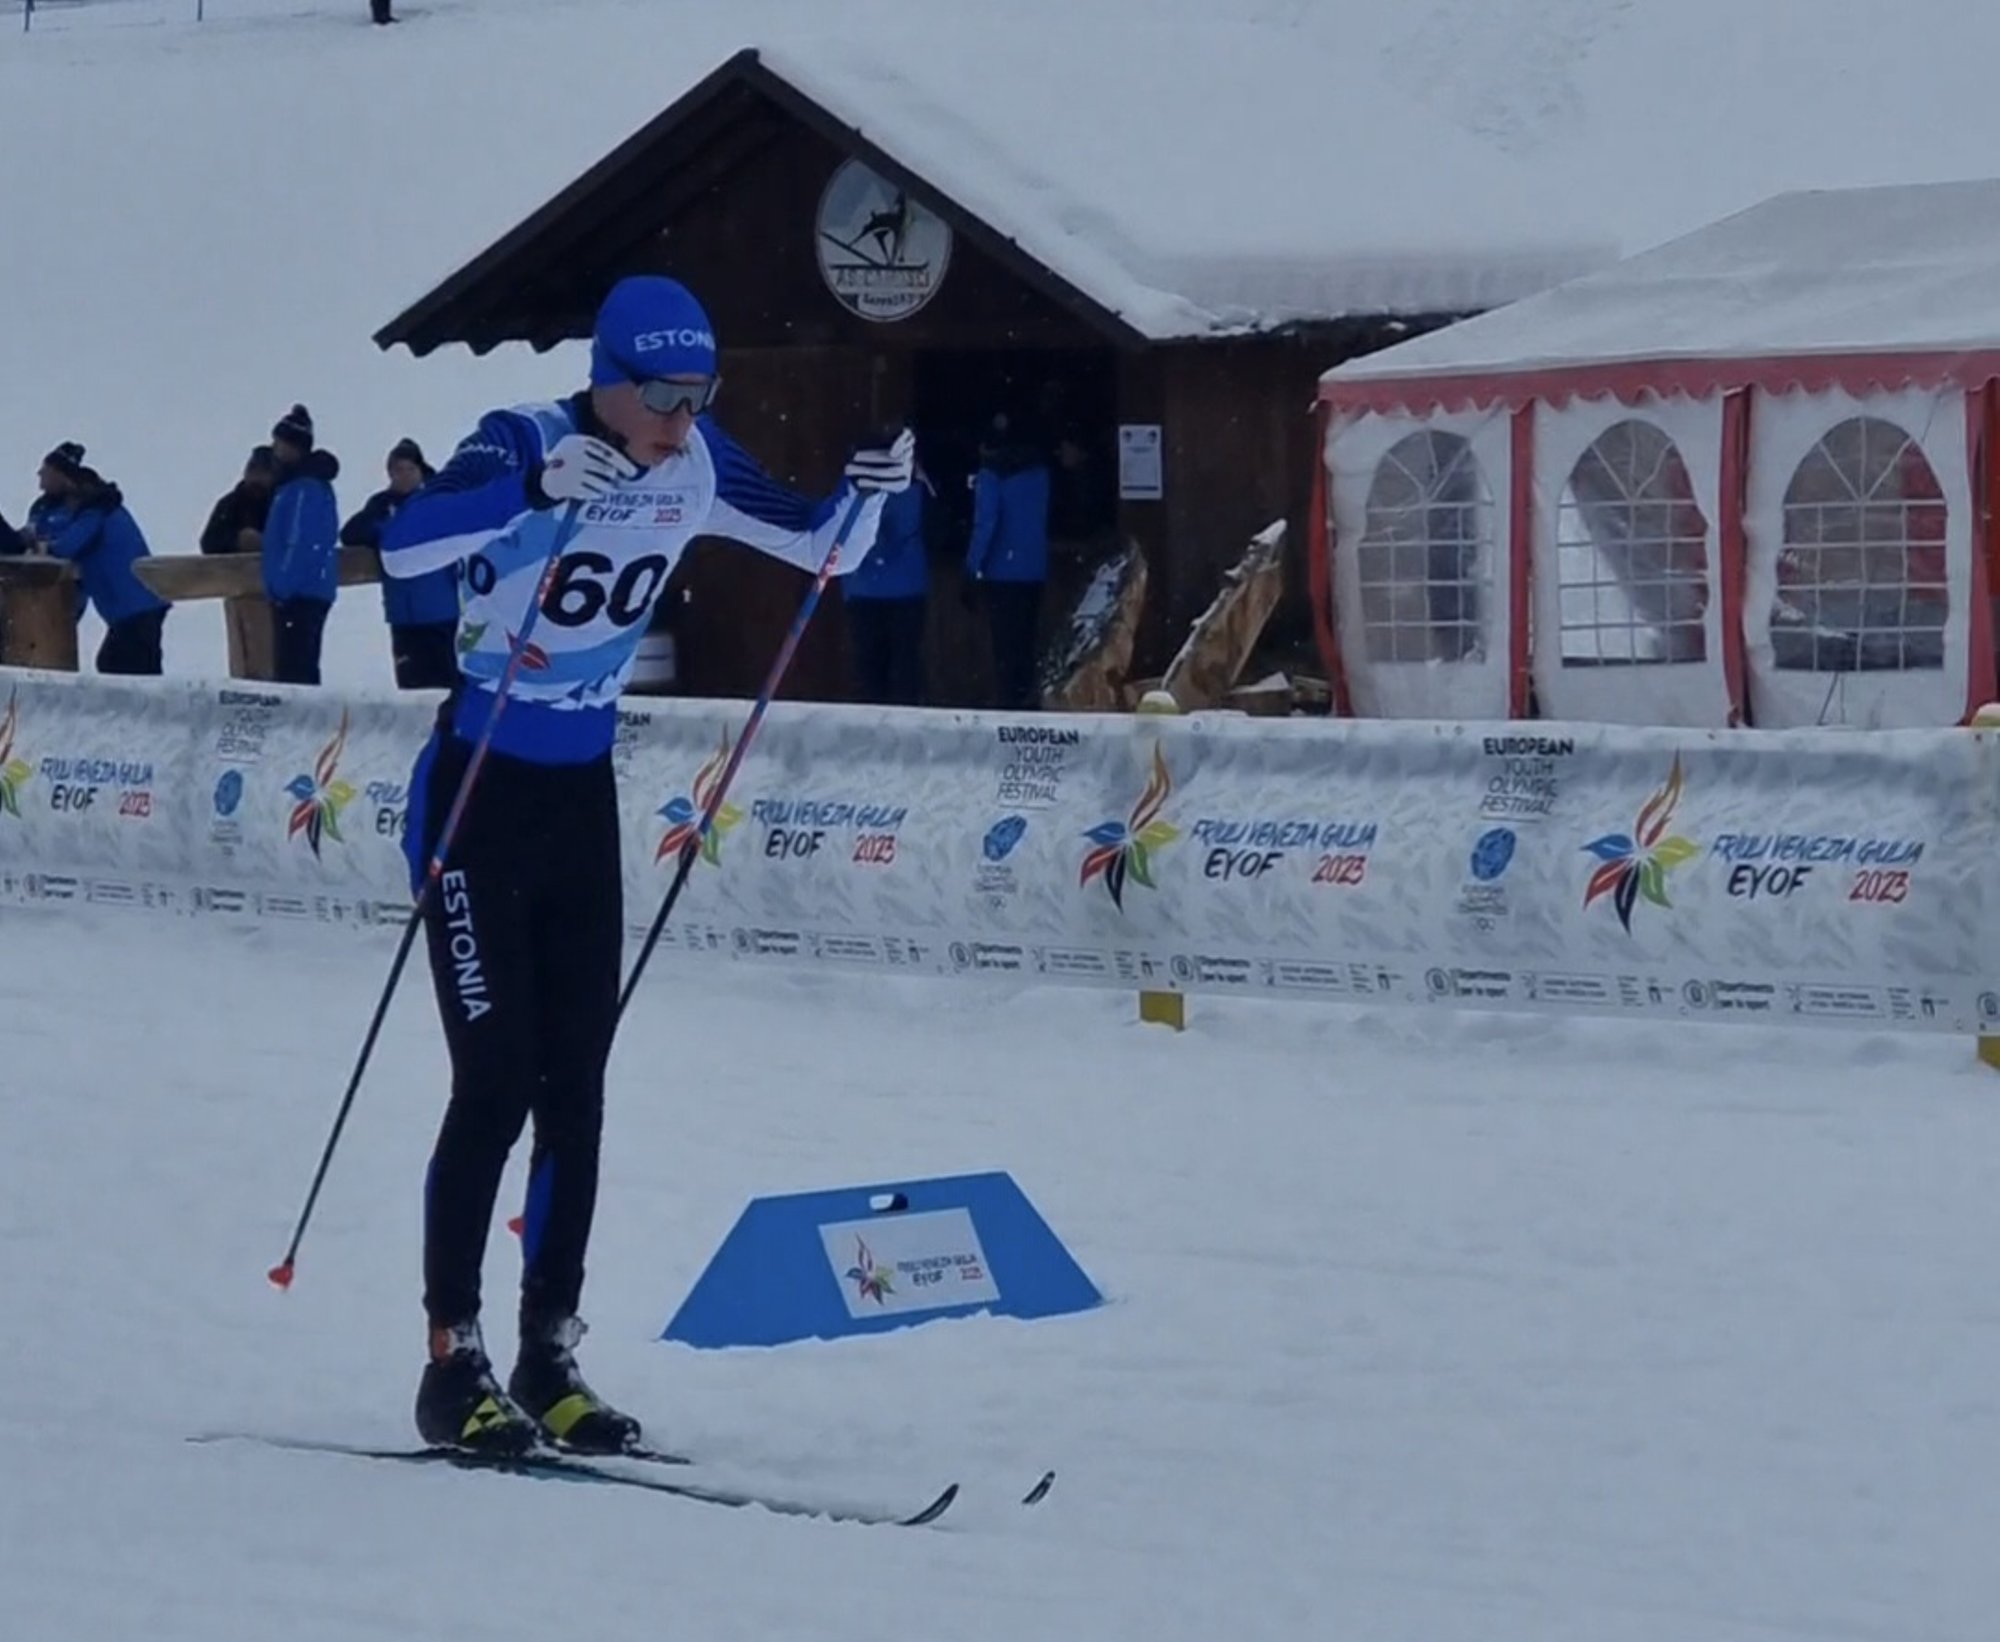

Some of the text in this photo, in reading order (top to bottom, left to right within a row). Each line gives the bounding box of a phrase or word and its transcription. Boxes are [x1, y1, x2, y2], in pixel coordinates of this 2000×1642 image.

[634, 329, 716, 352] ESTON
[585, 503, 636, 523] EYOF
[538, 550, 669, 628] 60
[997, 726, 1080, 745] EUROPEAN
[1482, 737, 1575, 757] EUROPEAN
[1015, 746, 1065, 764] YOUTH
[1002, 763, 1065, 783] OLYMPIC
[1503, 757, 1555, 777] YOUTH
[997, 782, 1058, 802] FESTIVAL
[1488, 775, 1559, 798] OLYMPIC
[51, 784, 98, 813] EYOF
[1479, 794, 1556, 816] FESTIVAL
[1247, 820, 1319, 849] VENEZIA
[764, 829, 897, 865] EYOF 2023
[1768, 834, 1857, 864] VENEZIA
[1855, 838, 1925, 867] GIULIA
[1203, 847, 1367, 885] EYOF 2023
[1726, 863, 1909, 903] EYOF 2023
[441, 869, 493, 1022] ESTONIA
